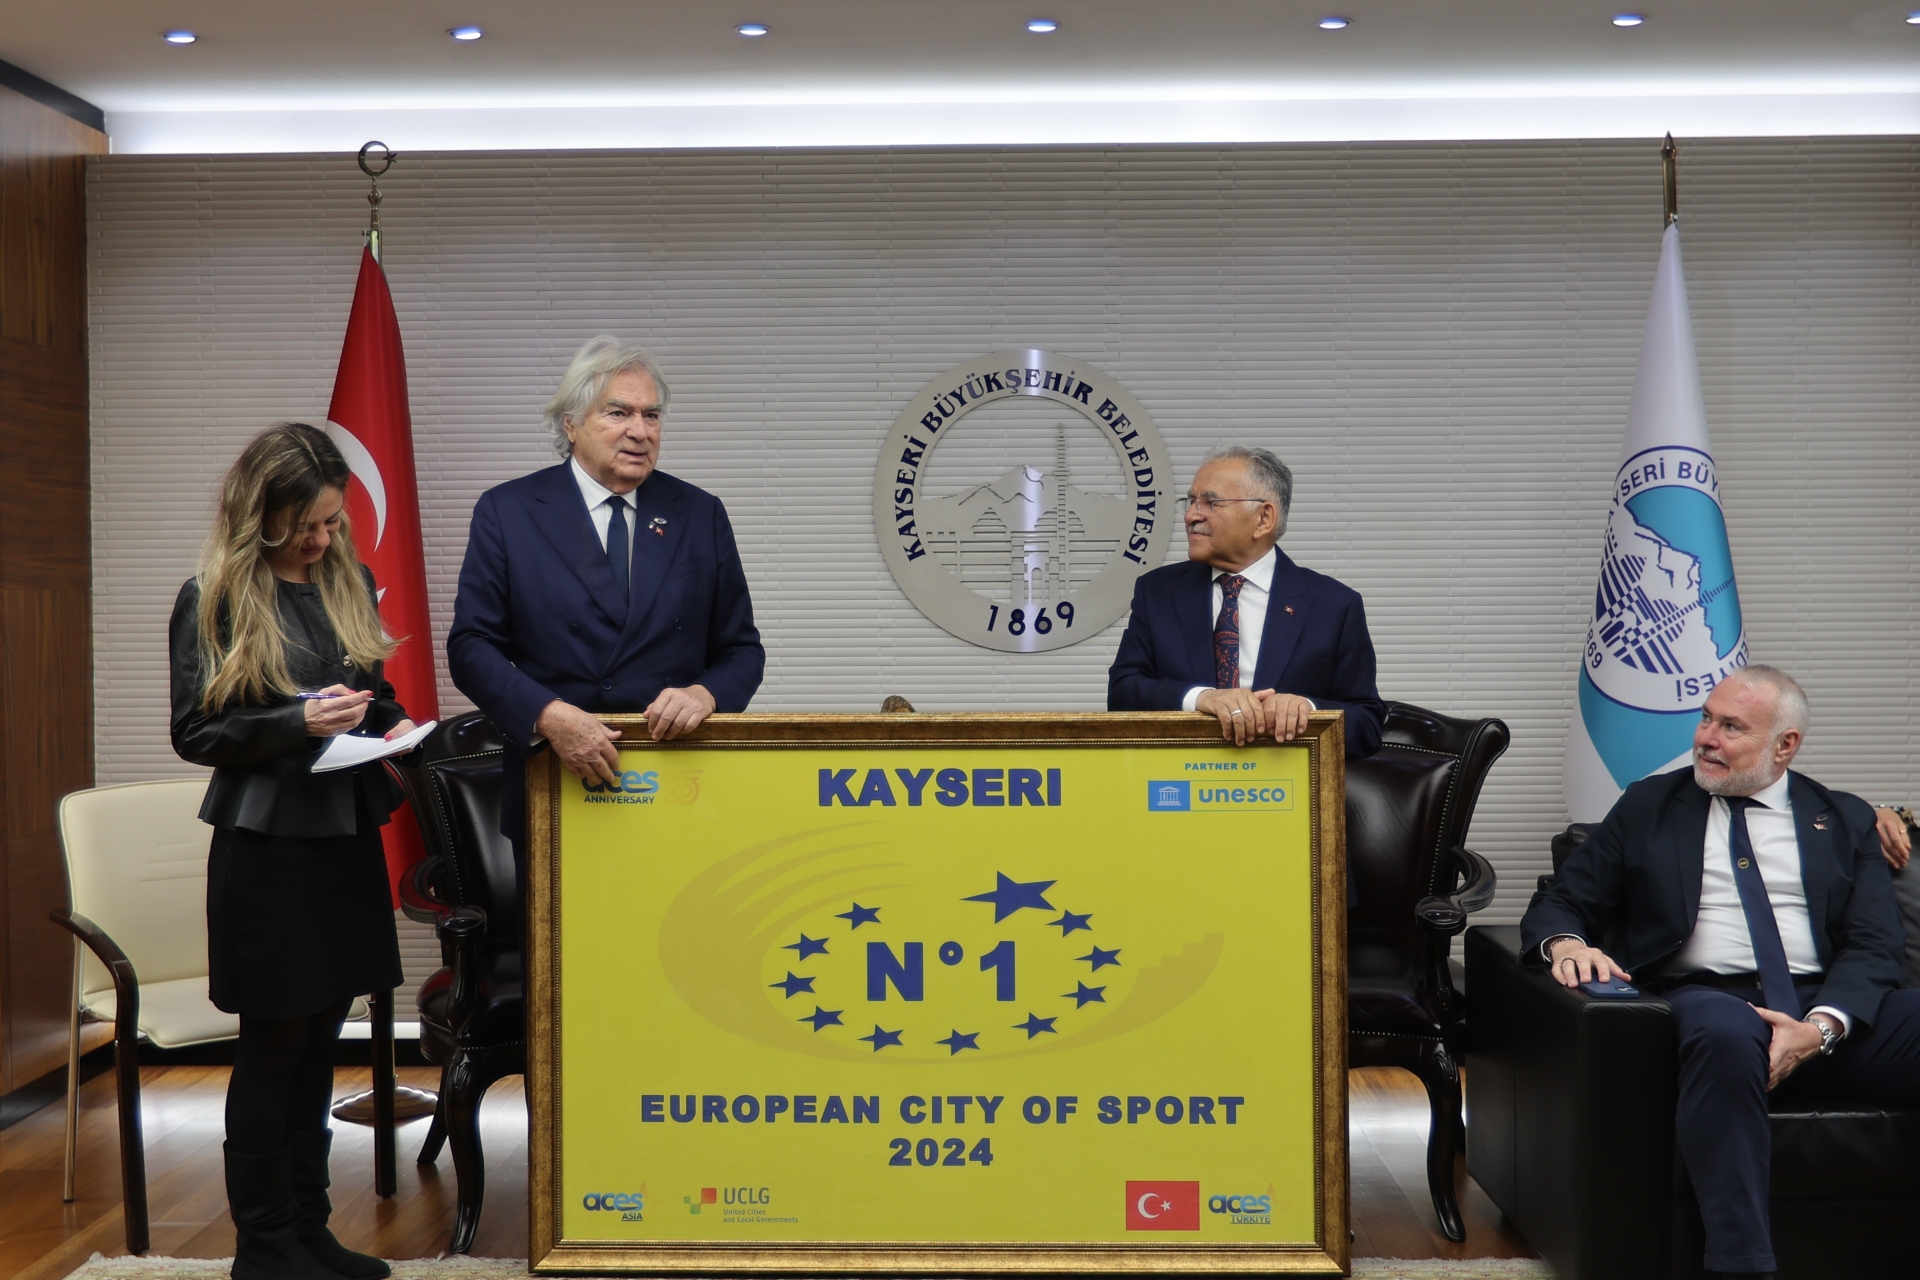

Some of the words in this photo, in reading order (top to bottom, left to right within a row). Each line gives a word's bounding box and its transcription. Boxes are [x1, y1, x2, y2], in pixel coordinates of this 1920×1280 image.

[895, 434, 928, 562] KAYSERİ
[920, 368, 1093, 434] BÜYÜKŞEHİR
[1095, 397, 1162, 566] BELEDİYESİ
[987, 601, 1075, 636] 1869
[1184, 762, 1238, 771] PARTNER
[1242, 762, 1257, 770] OF
[818, 768, 1062, 807] KAYSERI
[1198, 787, 1286, 803] unesco
[584, 794, 655, 805] ANNIVERSARY
[641, 1094, 880, 1124] EUROPEAN
[900, 1095, 1005, 1124] CITY
[1022, 1095, 1078, 1125] OF
[1097, 1095, 1245, 1125] SPORT
[888, 1137, 994, 1167] 2024
[583, 1192, 644, 1212] aces
[723, 1187, 770, 1205] UCLG
[1208, 1195, 1271, 1214] aces
[621, 1212, 643, 1221] ASIA
